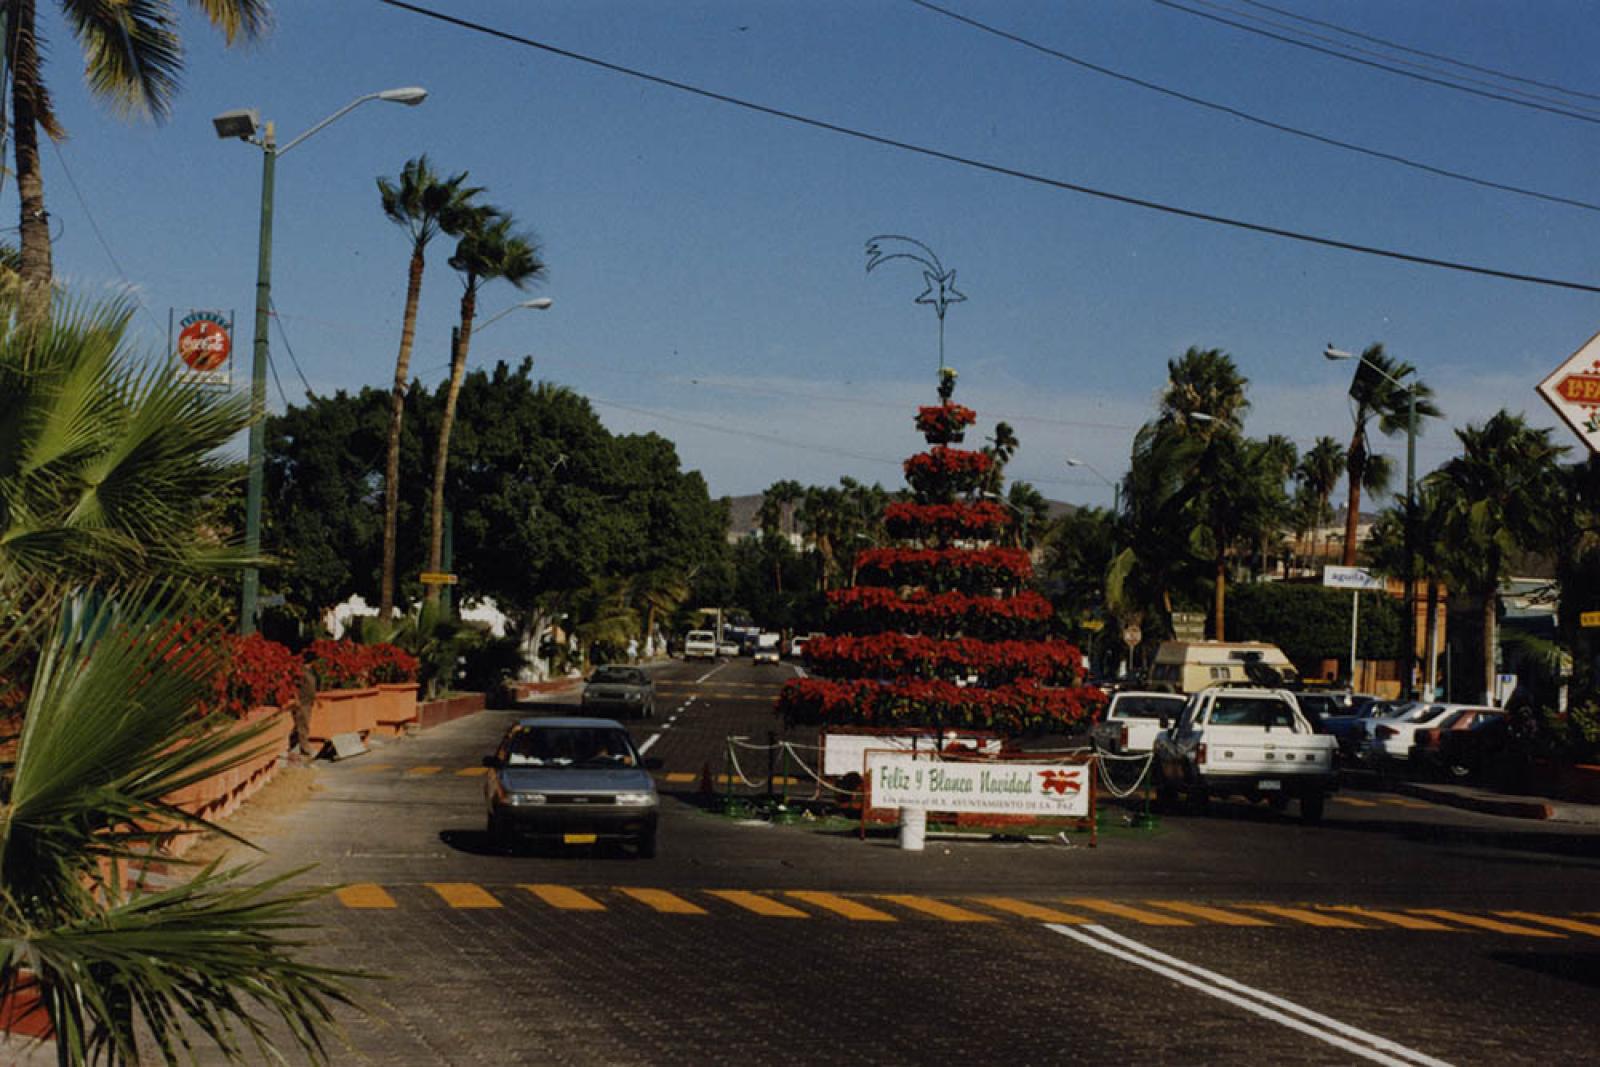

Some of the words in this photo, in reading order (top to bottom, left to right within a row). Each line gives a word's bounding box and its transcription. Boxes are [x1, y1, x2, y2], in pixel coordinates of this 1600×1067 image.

[880, 765, 909, 790] Feliz
[928, 768, 973, 793] Blanca
[980, 771, 1032, 794] Navidad
